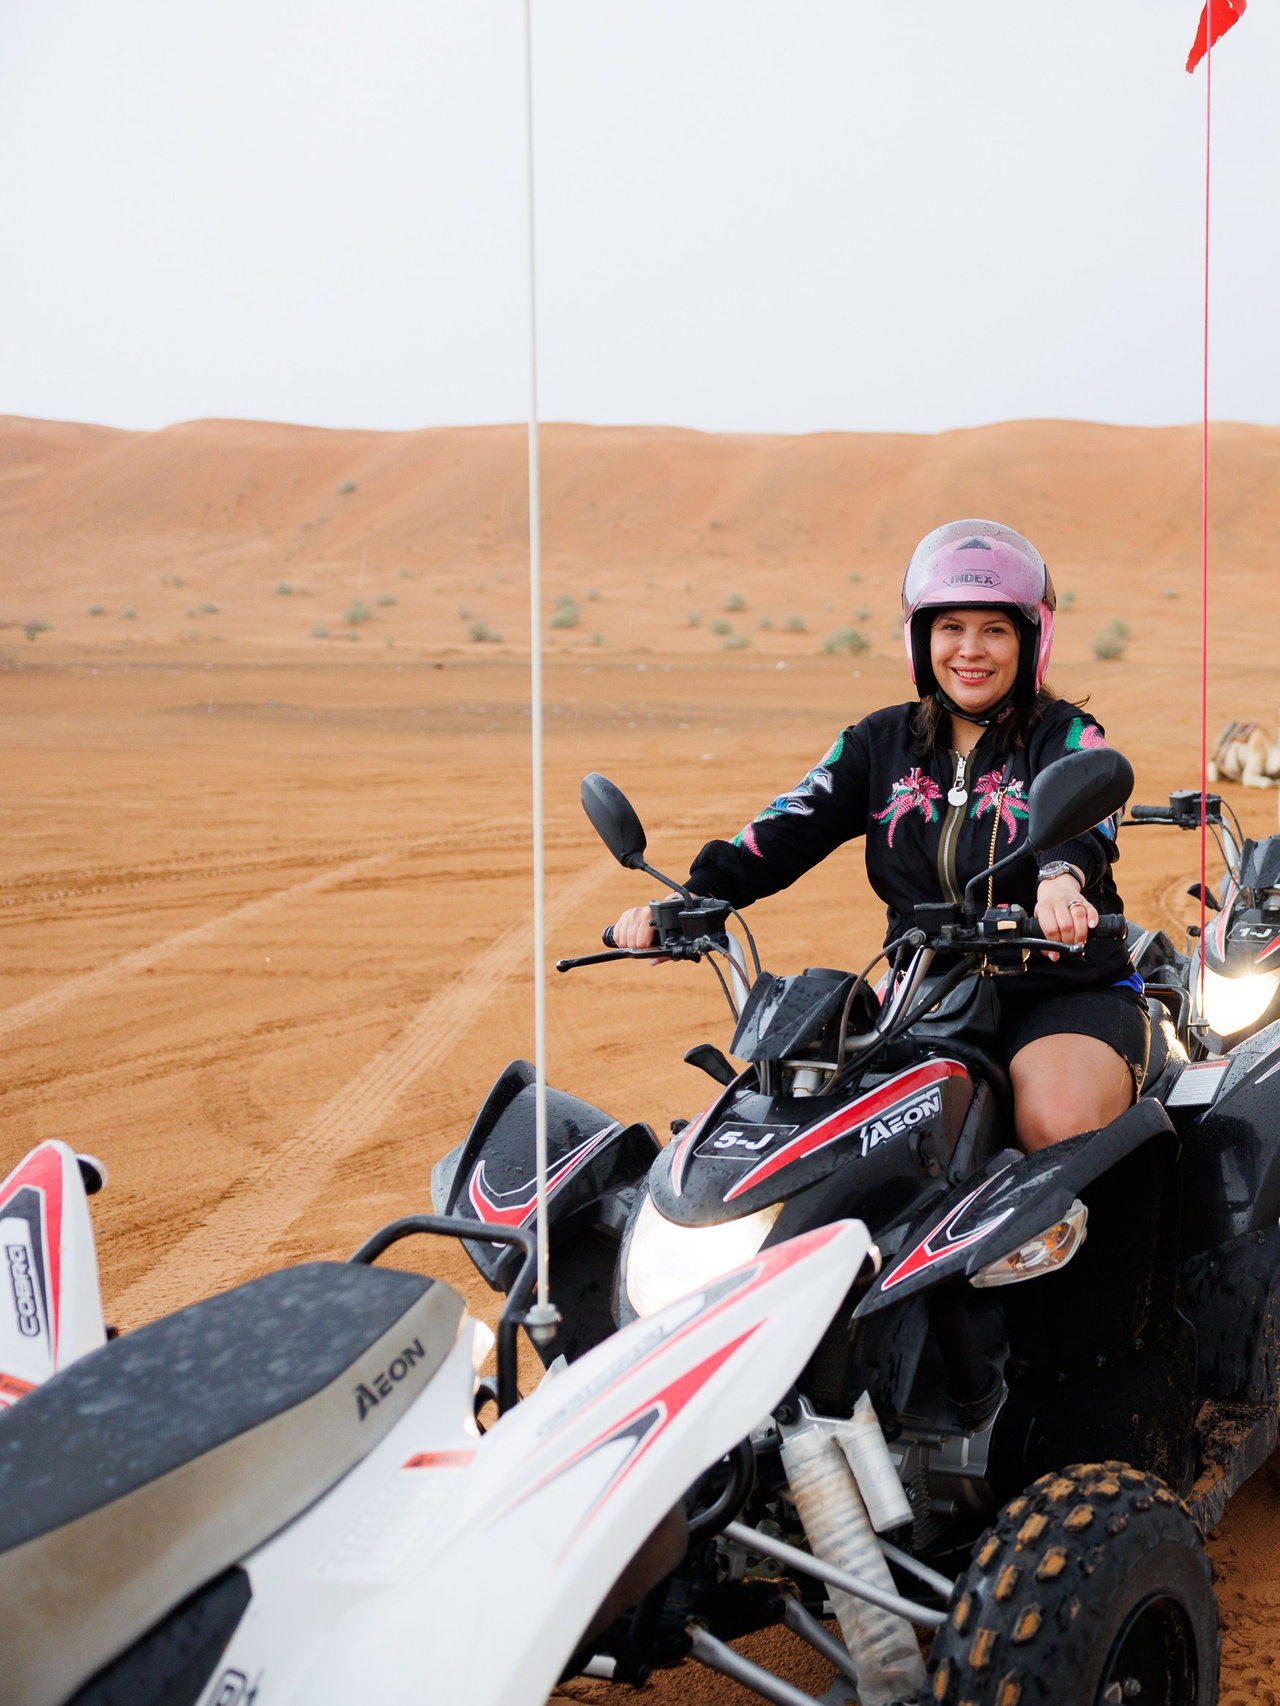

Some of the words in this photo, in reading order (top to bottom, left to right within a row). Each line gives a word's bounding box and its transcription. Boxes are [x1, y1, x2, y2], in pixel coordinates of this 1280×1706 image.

[950, 574, 993, 585] INDEX
[1239, 928, 1272, 938] 1-J
[713, 1130, 775, 1150] 5-J
[868, 1096, 942, 1148] AEON
[5, 1244, 40, 1337] COBRA
[354, 1338, 425, 1421] AEON
